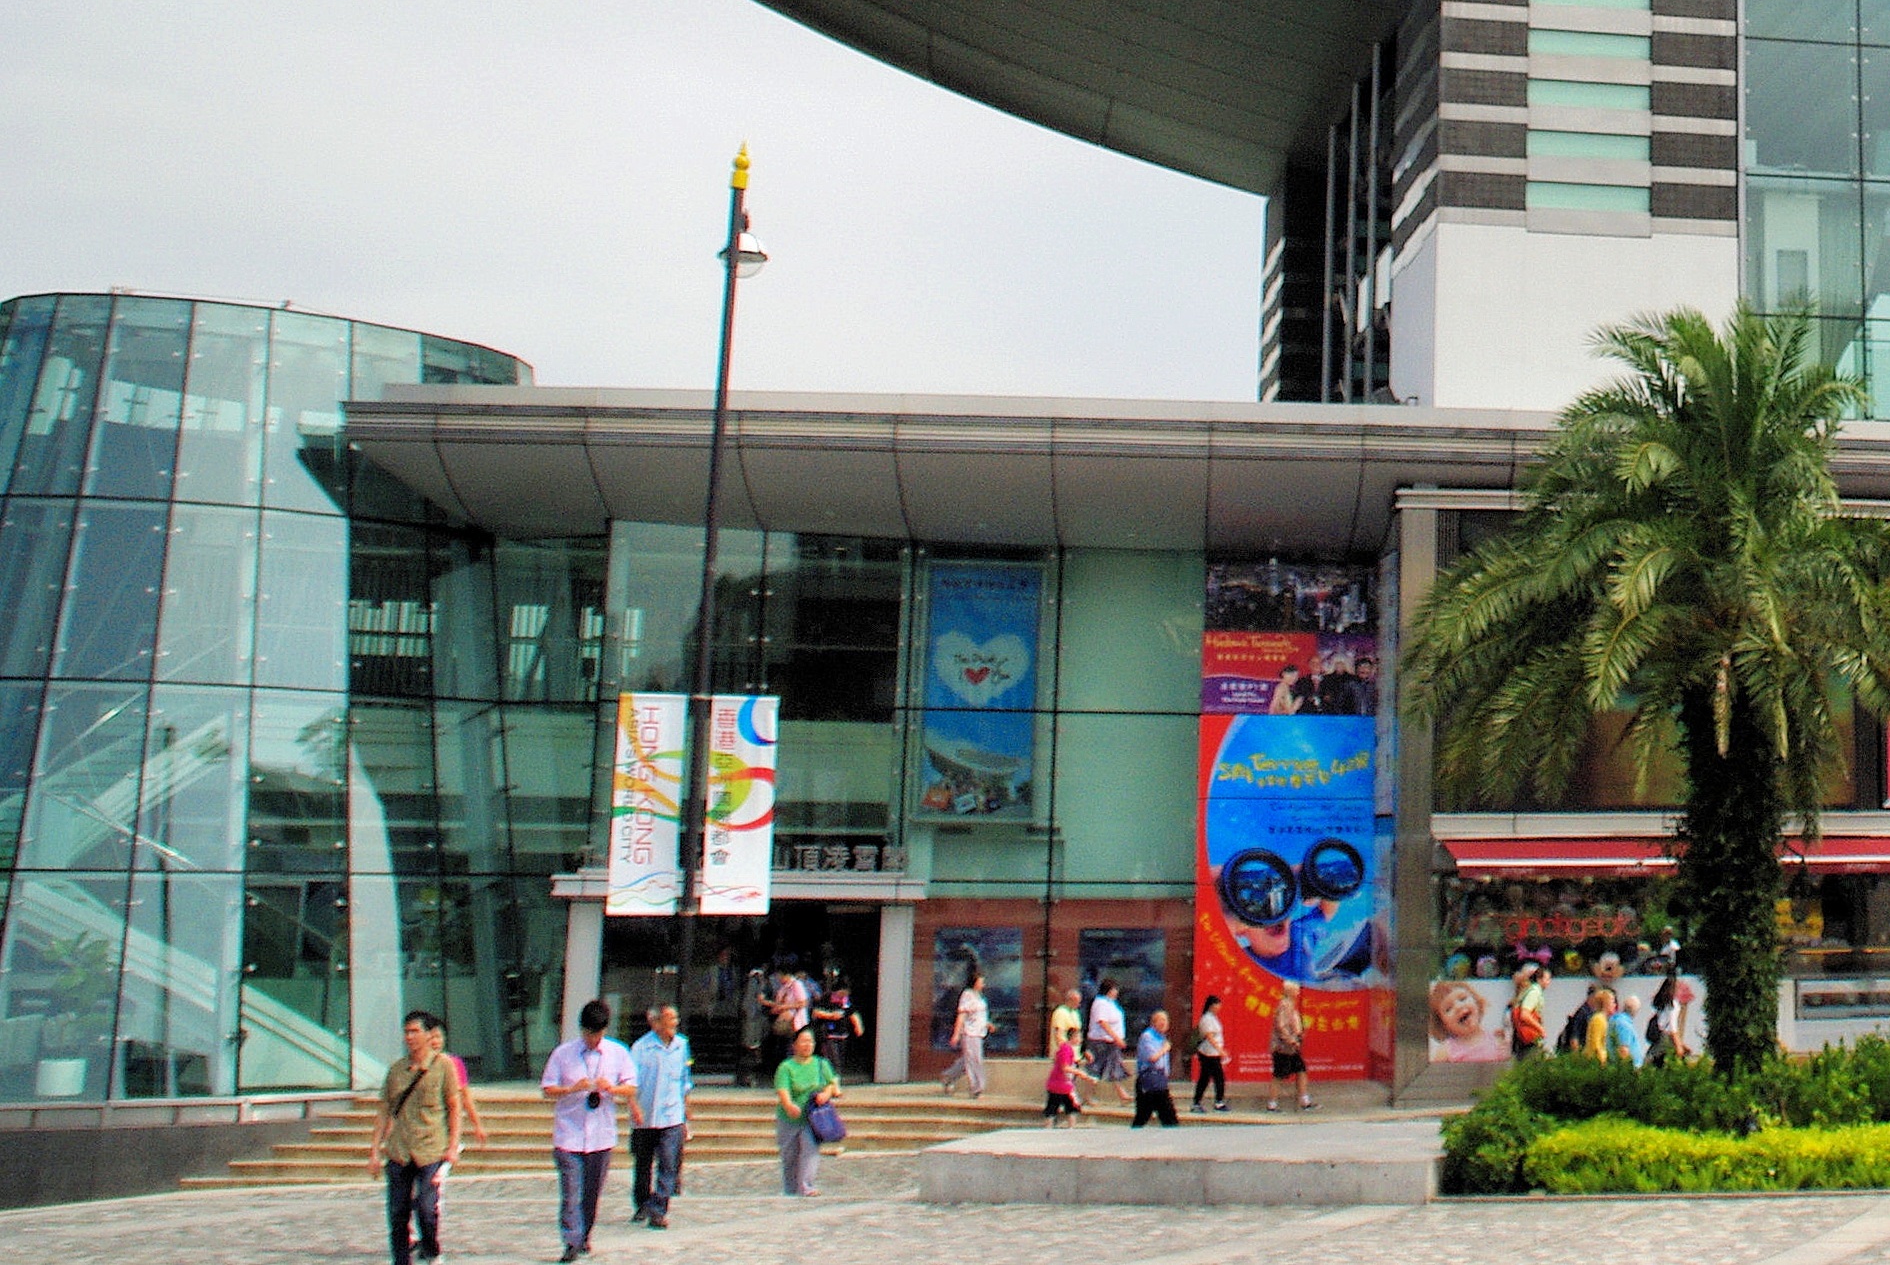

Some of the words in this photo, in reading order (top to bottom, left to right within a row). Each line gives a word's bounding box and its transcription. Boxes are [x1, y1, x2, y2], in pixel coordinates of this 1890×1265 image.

[637, 706, 659, 782] HONG
[619, 826, 635, 865] CITY
[632, 788, 656, 865] KONG
